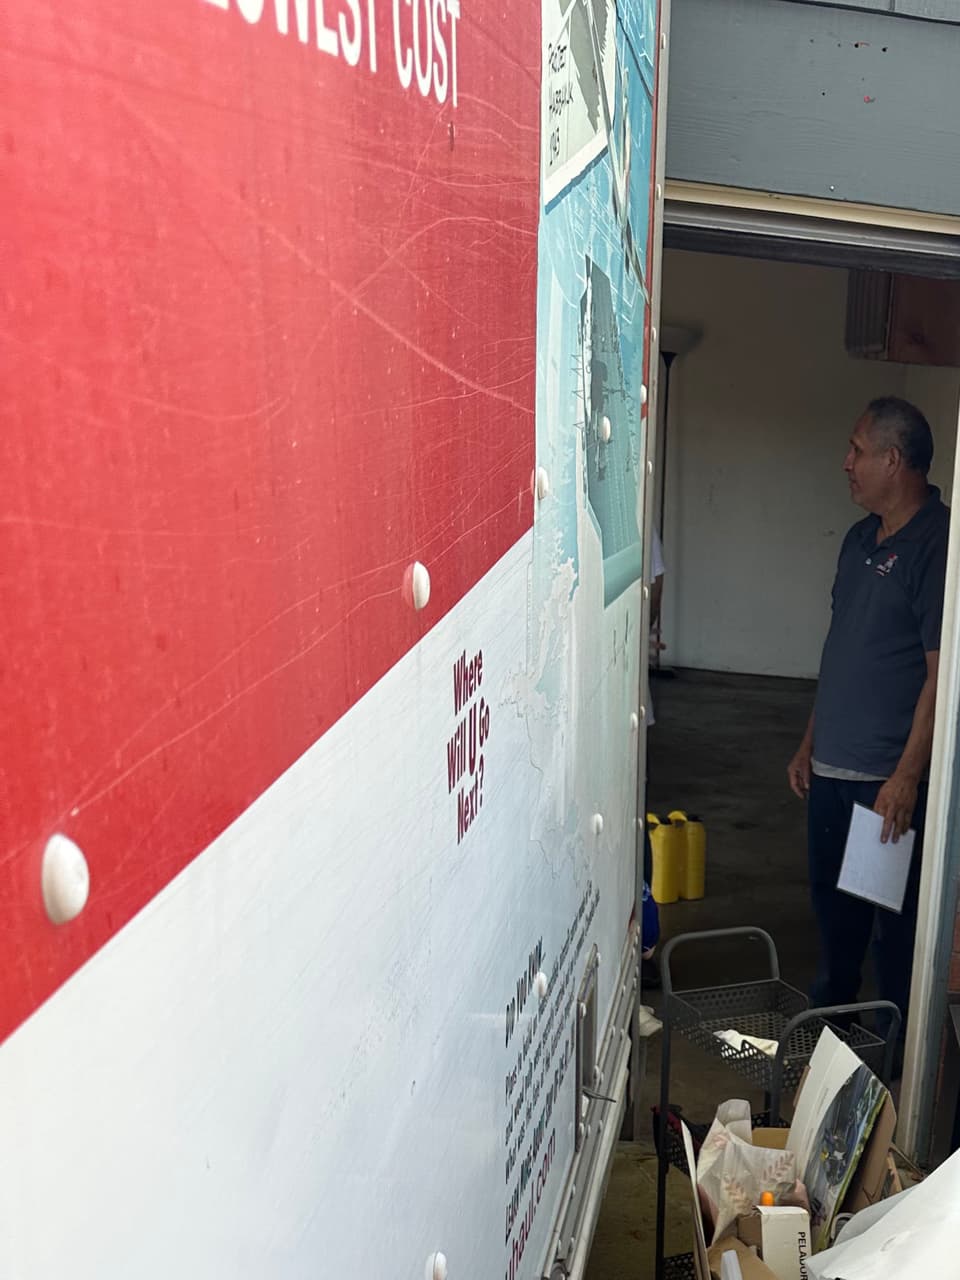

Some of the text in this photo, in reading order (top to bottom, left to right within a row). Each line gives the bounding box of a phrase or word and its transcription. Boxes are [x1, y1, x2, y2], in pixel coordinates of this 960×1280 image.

[393, 0, 460, 108] COST
[453, 649, 483, 716] Where
[447, 697, 490, 794] Will U Go
